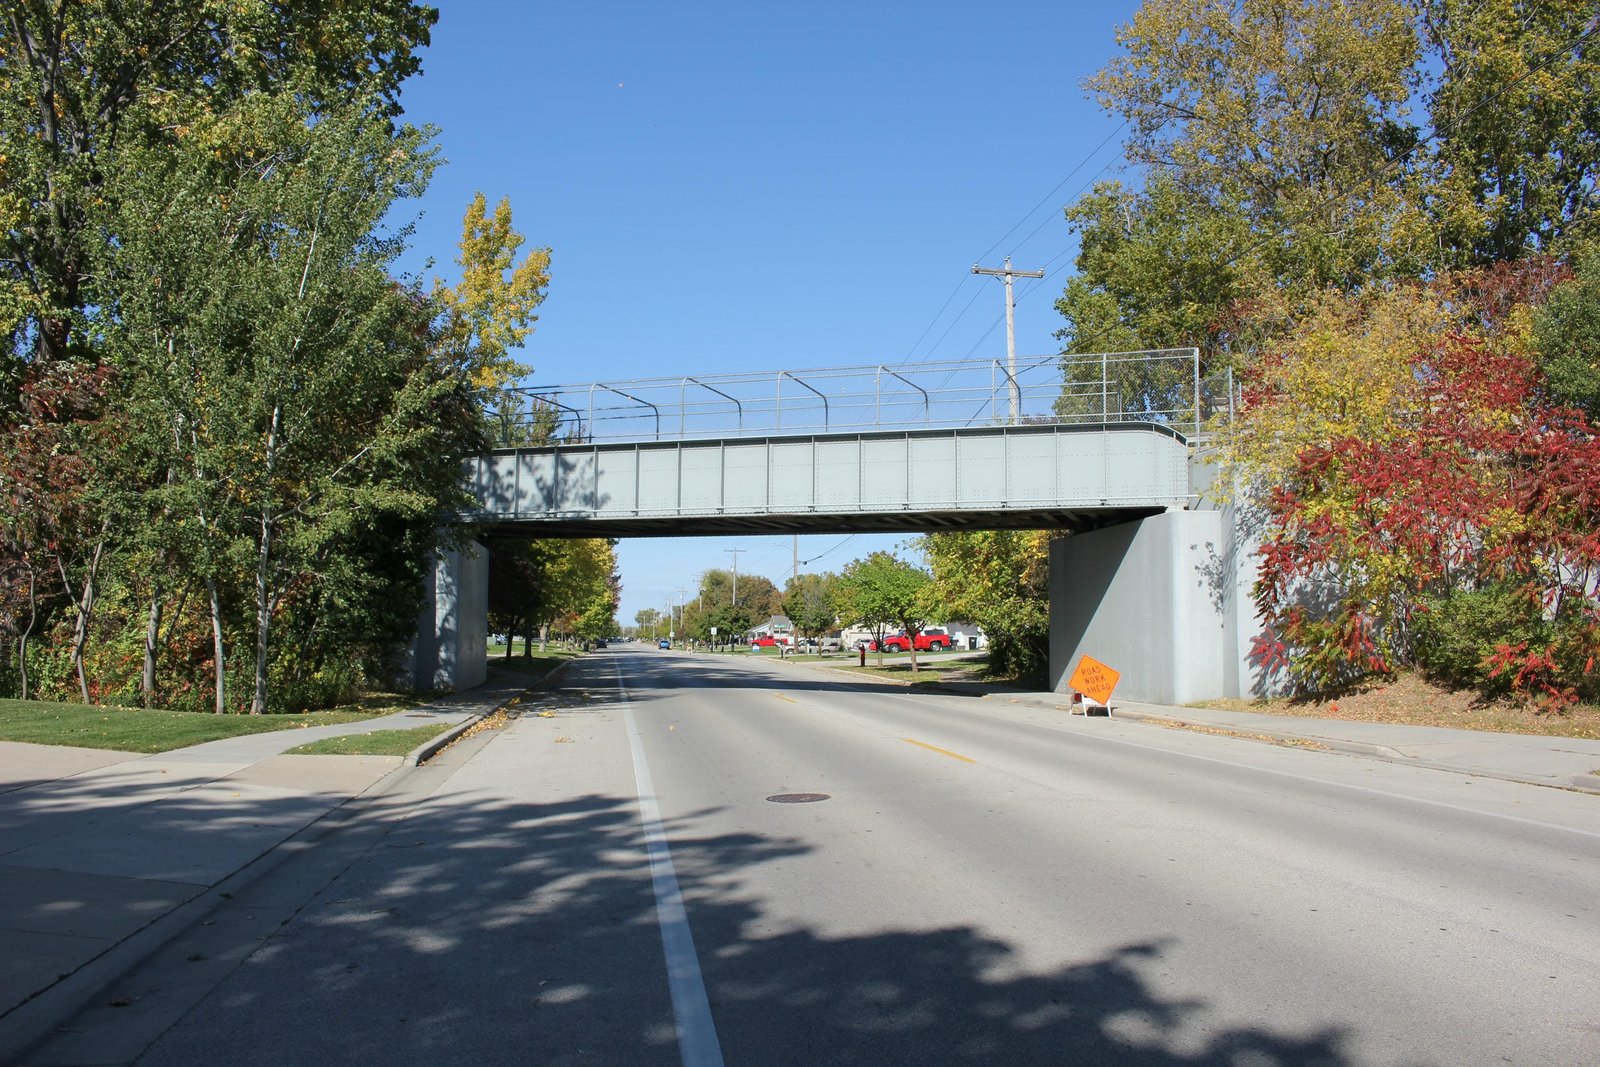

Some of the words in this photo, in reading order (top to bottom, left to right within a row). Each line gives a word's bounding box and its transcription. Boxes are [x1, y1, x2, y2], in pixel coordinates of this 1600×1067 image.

[1081, 666, 1101, 676] ROAD
[1084, 675, 1106, 684] WORK
[1087, 683, 1111, 694] AHEAD
